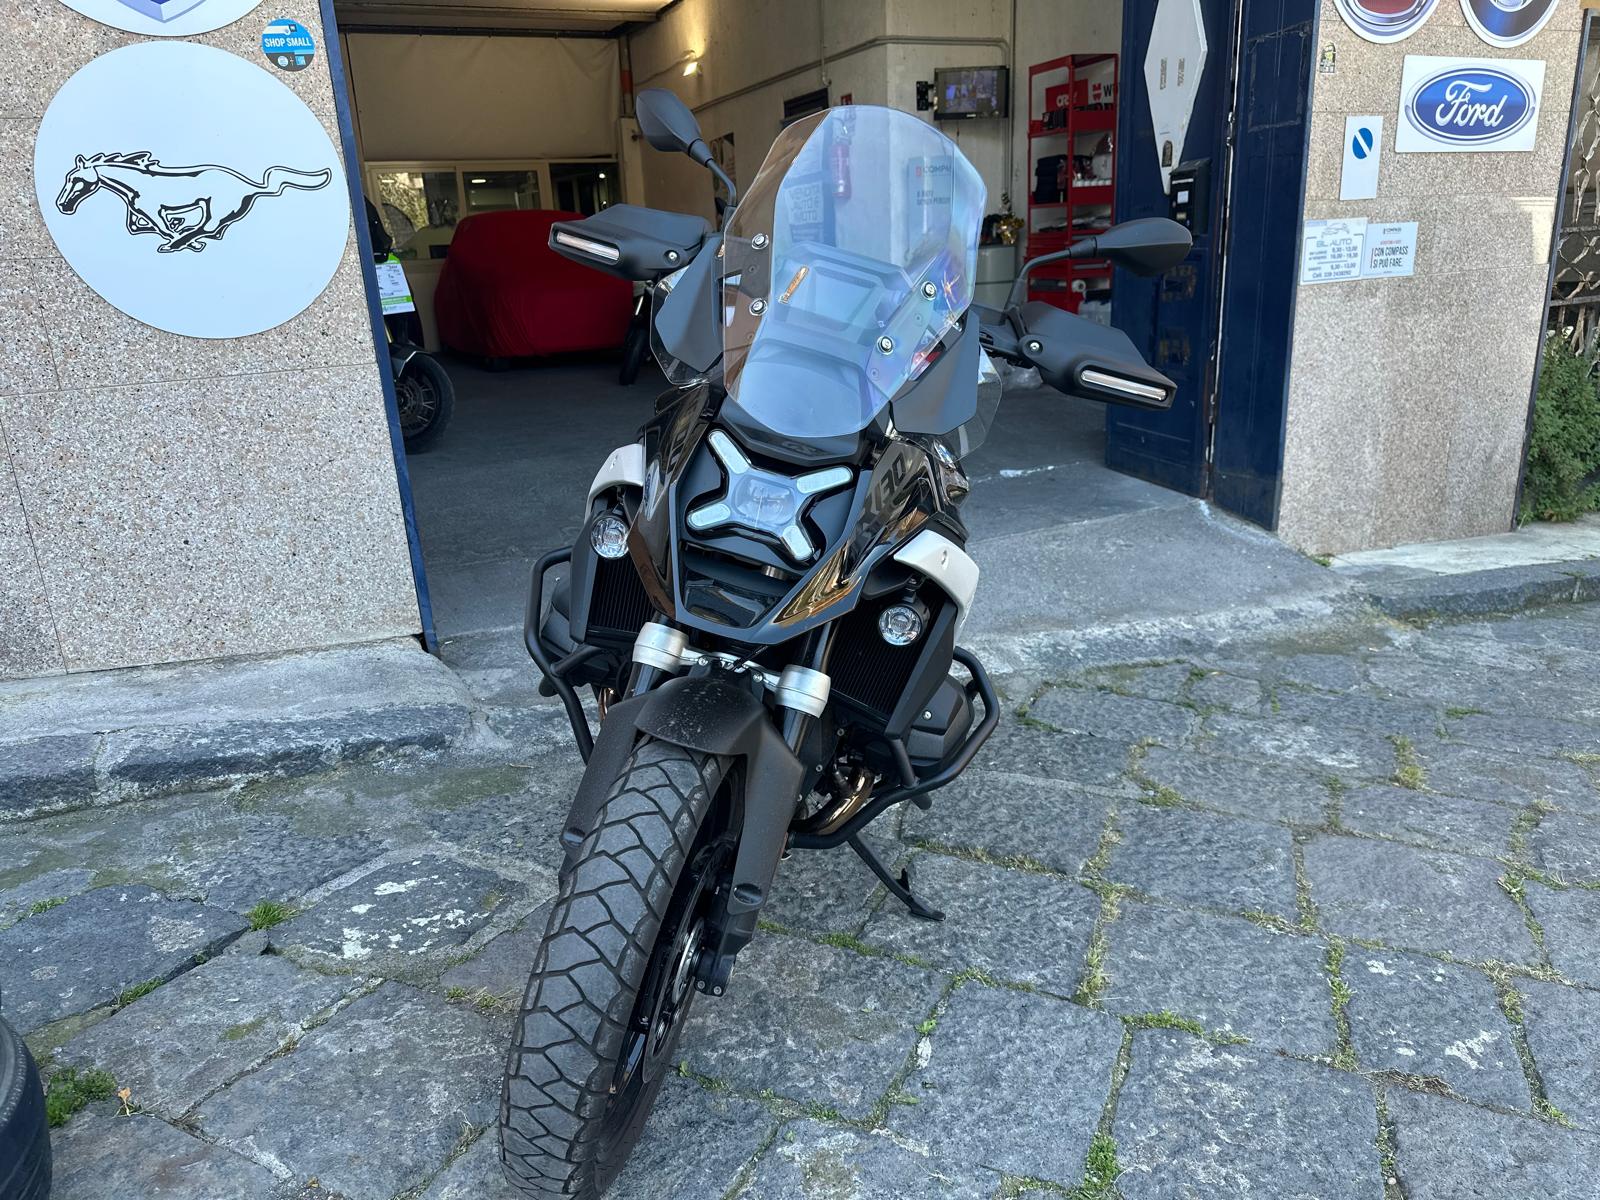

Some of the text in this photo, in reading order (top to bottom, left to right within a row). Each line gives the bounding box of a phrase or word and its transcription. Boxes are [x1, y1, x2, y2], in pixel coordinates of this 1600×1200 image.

[264, 37, 312, 48] SHOP SMALL
[1435, 80, 1508, 127] Ford
[1329, 238, 1352, 247] AUTO
[1374, 245, 1408, 257] CON COMPASS
[1372, 258, 1378, 269] SI
